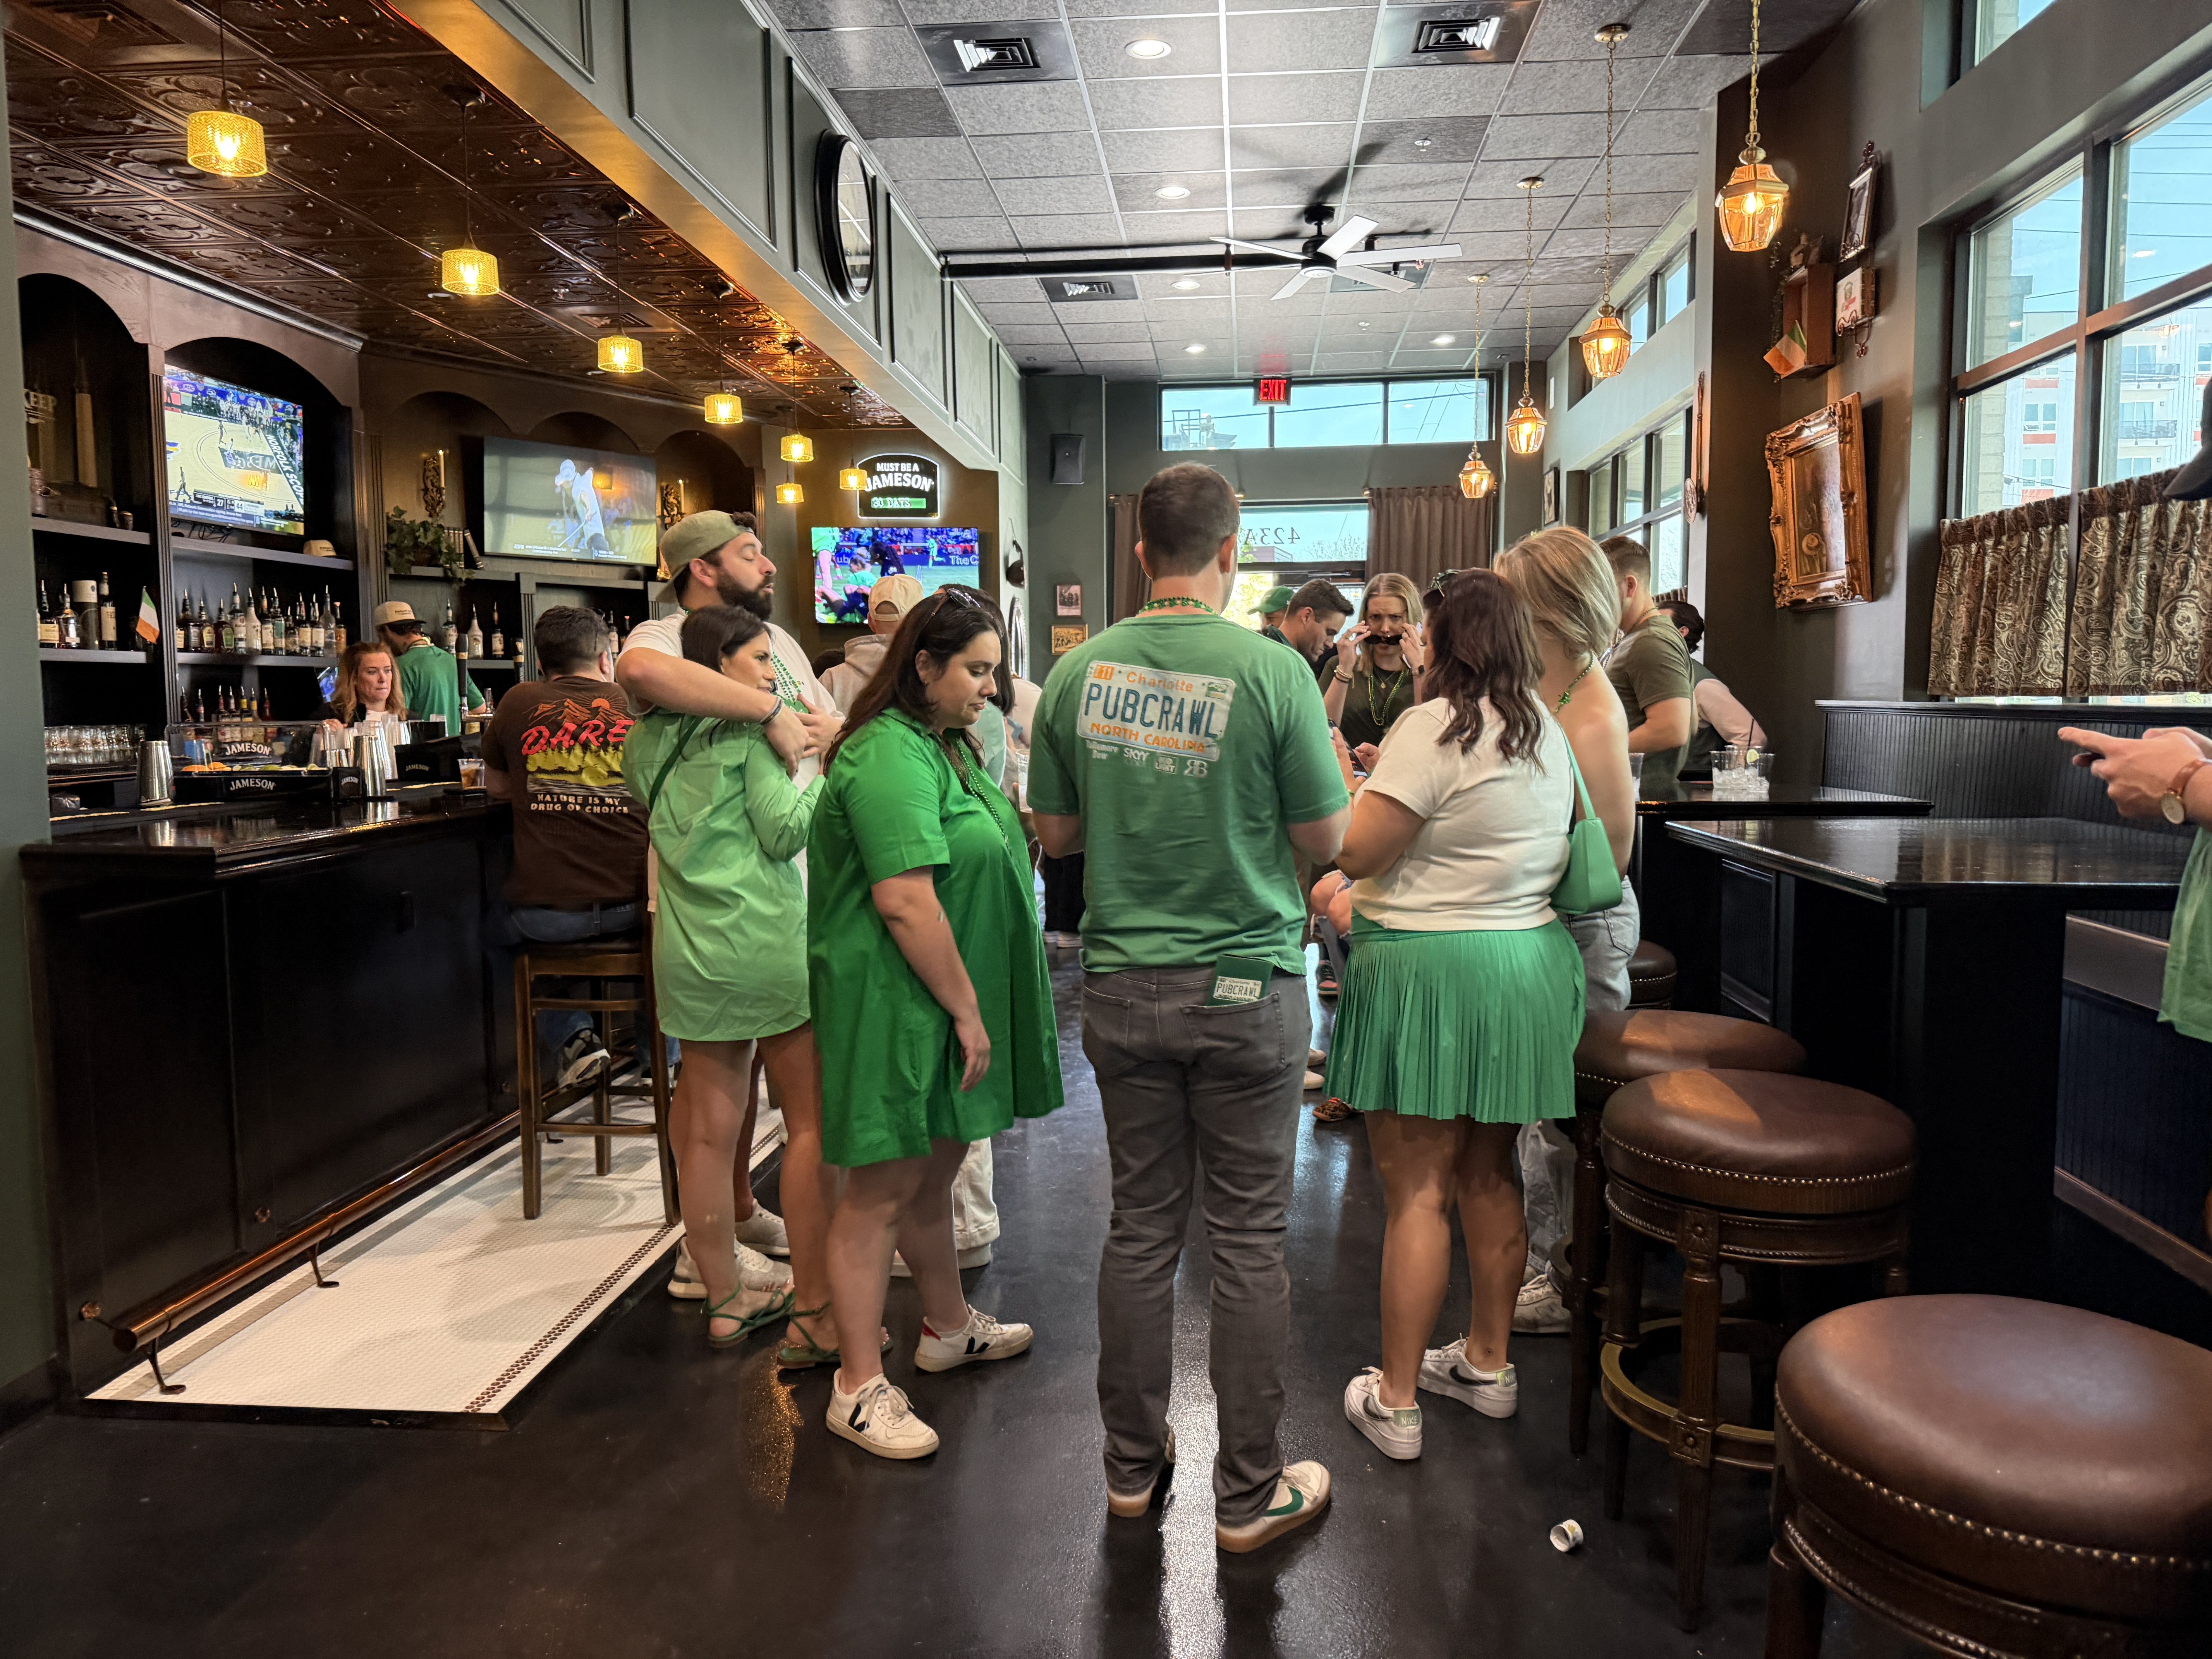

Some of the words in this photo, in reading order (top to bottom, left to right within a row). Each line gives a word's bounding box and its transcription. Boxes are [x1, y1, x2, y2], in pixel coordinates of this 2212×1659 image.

[1260, 380, 1287, 400] EXIT
[266, 434, 294, 472] NORFOLK
[876, 463, 900, 471] MUST
[901, 463, 911, 471] BE
[912, 463, 919, 471] A
[865, 472, 932, 491] JAMESON
[886, 497, 910, 508] DAYS
[949, 555, 970, 565] The
[1126, 672, 1194, 692] Charlotte
[1084, 683, 1218, 738] PUBCRAWL
[1091, 723, 1139, 741] NORTH
[1144, 734, 1206, 754] CAROLINA
[225, 743, 270, 755] JAMESON
[230, 778, 275, 790] JAMESON
[537, 794, 582, 803] NATURE
[1216, 983, 1257, 997] PUBCRAWL
[1402, 1416, 1417, 1425] NIKE
